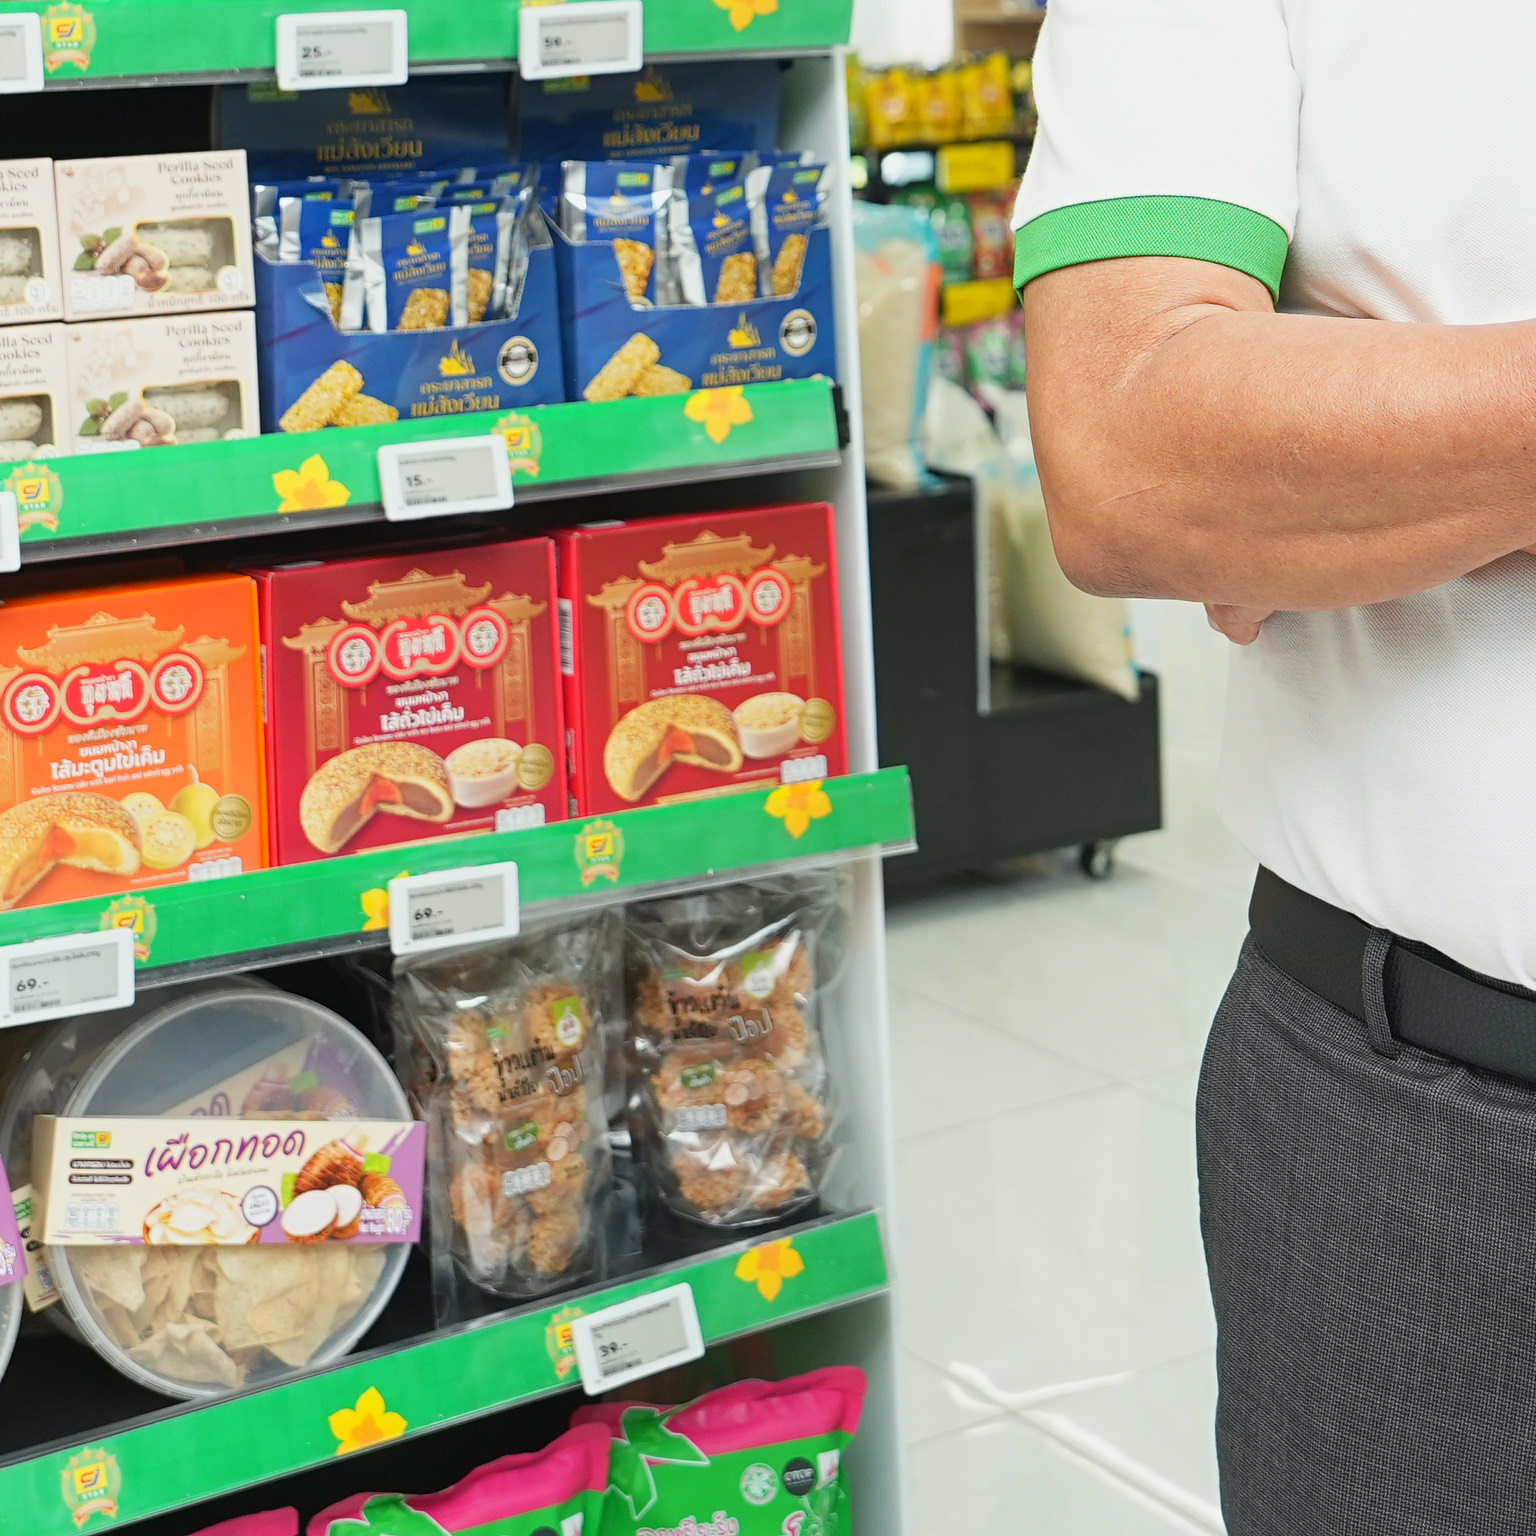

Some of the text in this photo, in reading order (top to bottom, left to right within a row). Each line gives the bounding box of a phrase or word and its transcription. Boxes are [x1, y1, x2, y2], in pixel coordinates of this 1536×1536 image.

[8, 166, 40, 179] Seed
[156, 158, 235, 175] Perilla Seed
[171, 171, 224, 186] Cookies
[14, 304, 37, 316] 100
[21, 333, 53, 346] Seed
[410, 391, 500, 418] แม่สังเวียน
[405, 473, 435, 489] 15.-
[50, 744, 166, 780] ไส้มะตูมไข่เค็ม
[413, 906, 445, 923] 69.-
[15, 976, 50, 993] 69.-
[143, 1128, 307, 1179] เผือกทอด
